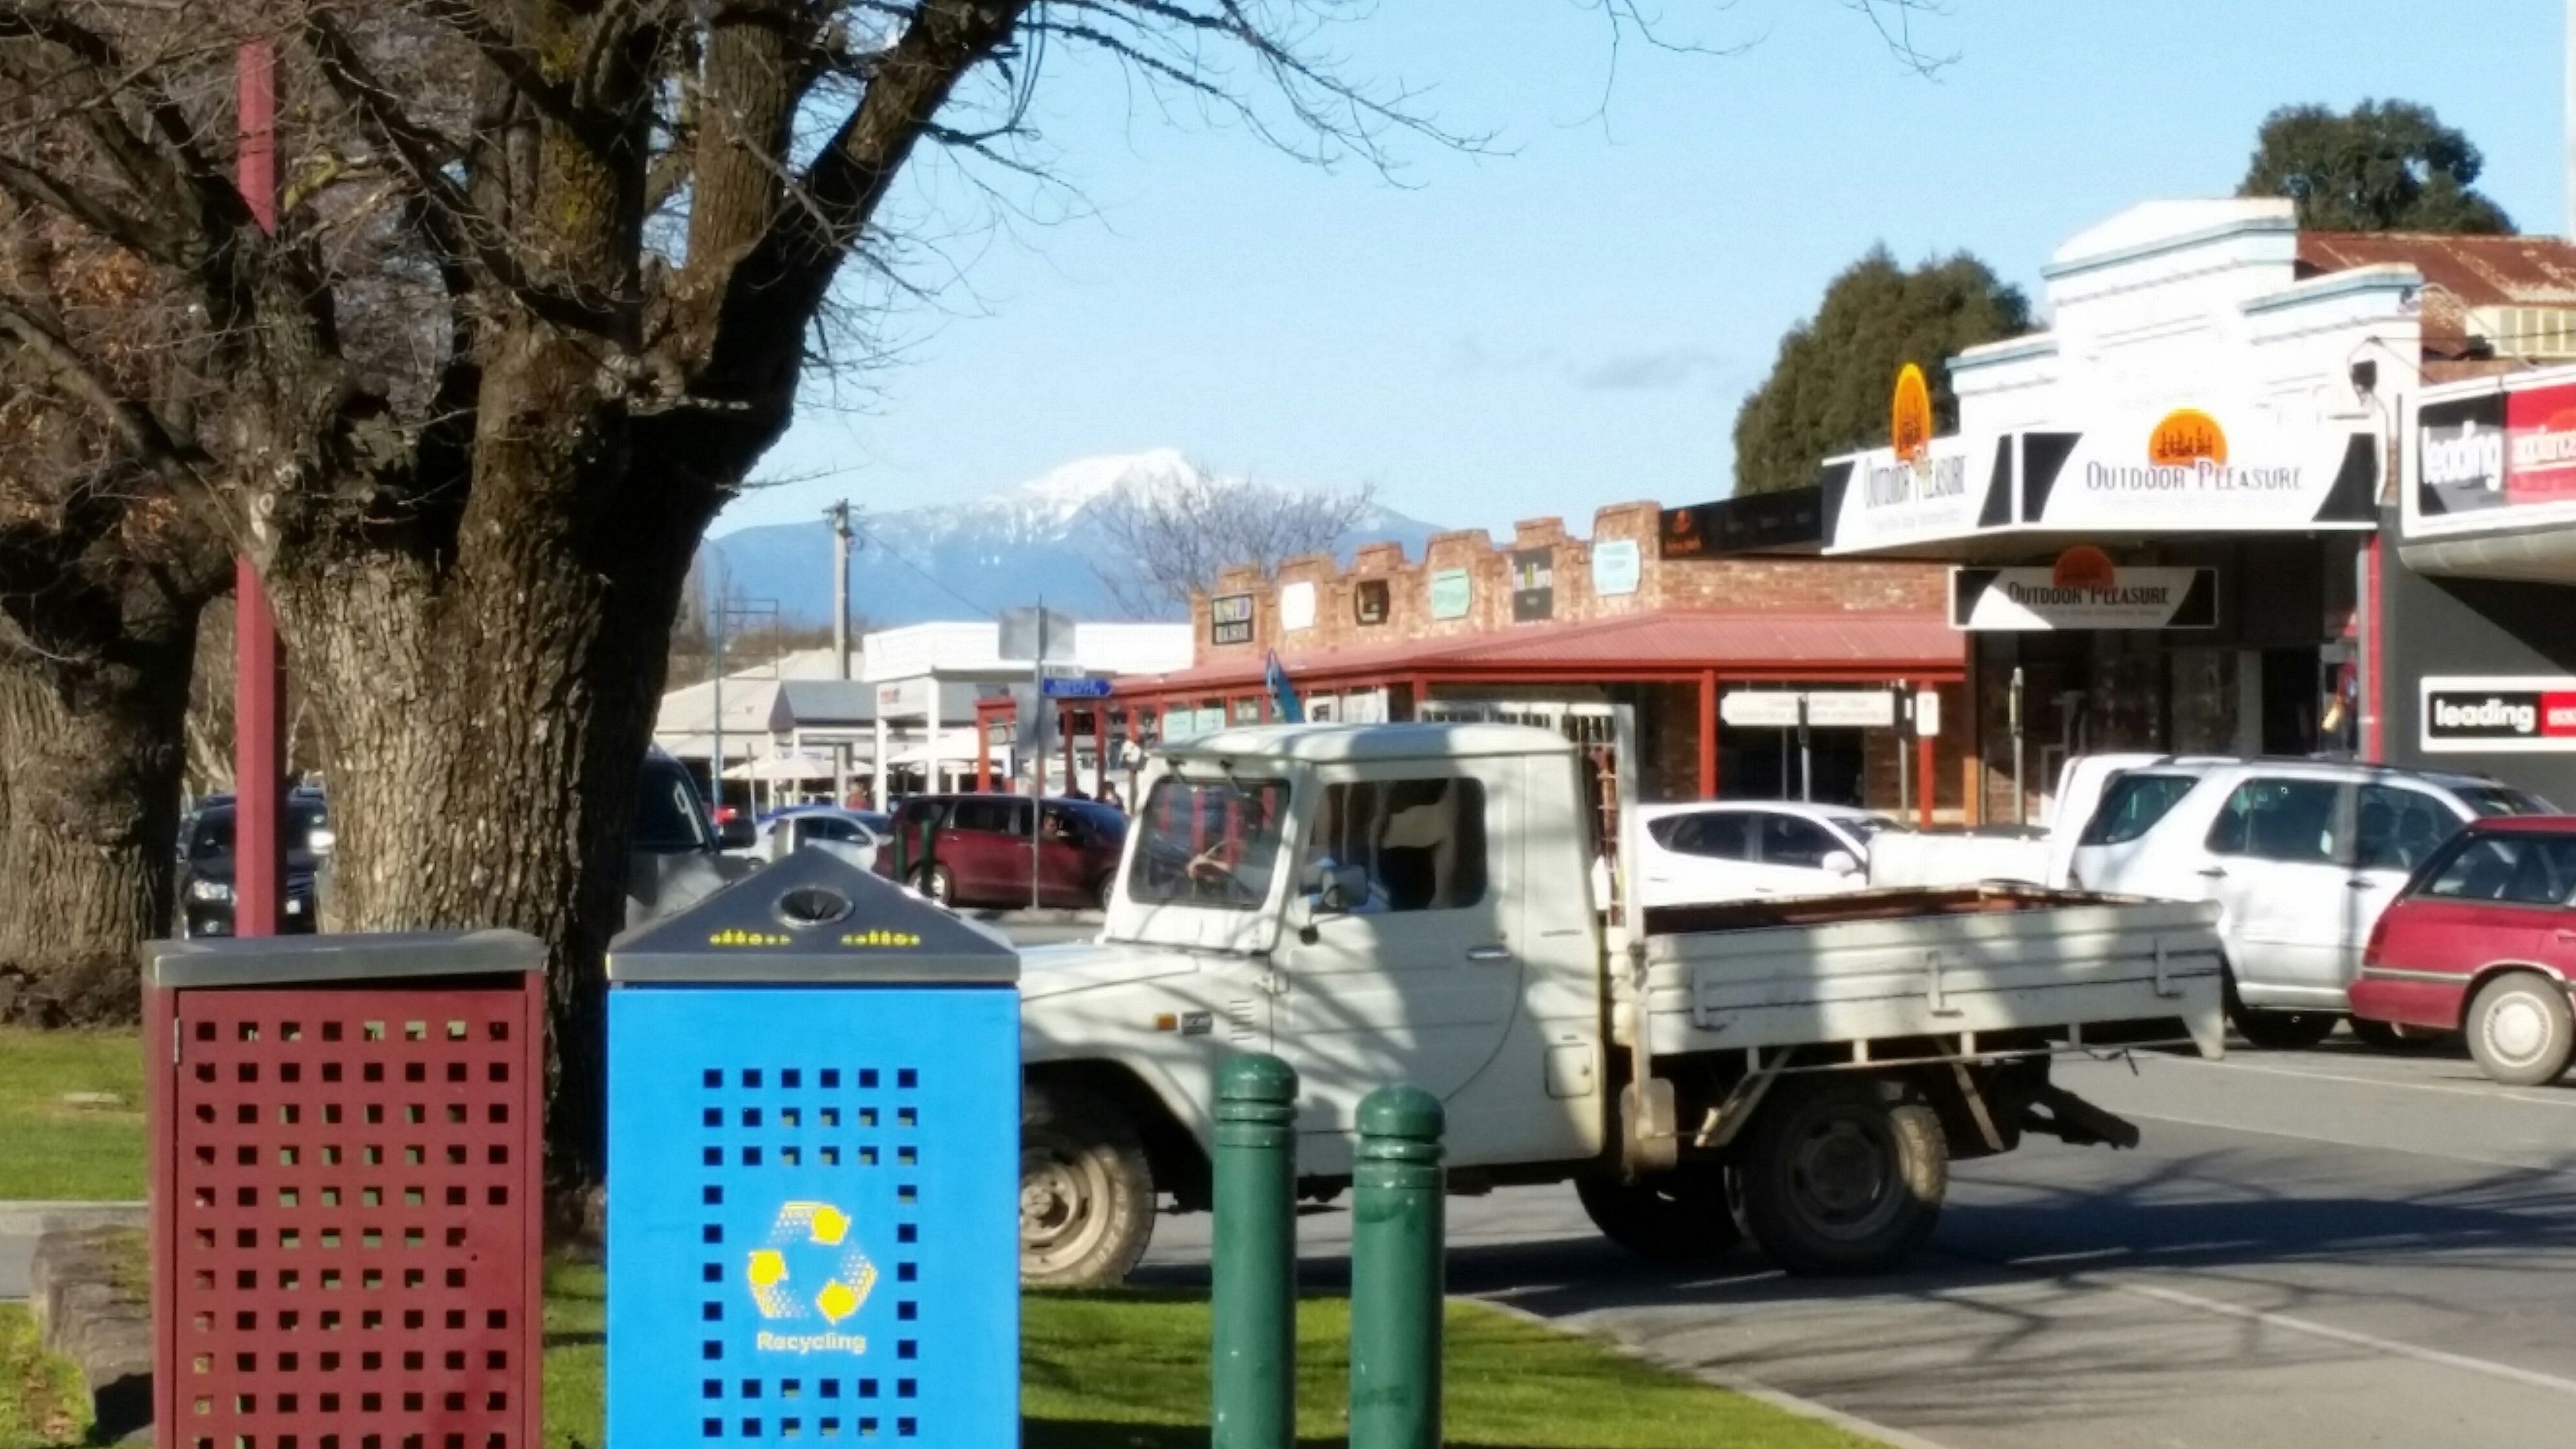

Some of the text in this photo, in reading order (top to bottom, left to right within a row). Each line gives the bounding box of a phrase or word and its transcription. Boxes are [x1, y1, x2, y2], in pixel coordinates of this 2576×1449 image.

[2422, 419, 2502, 492] leading
[2086, 461, 2304, 490] OUTDOOR PLEASURE
[2008, 582, 2169, 604] OUTDOOR PLEASURE
[2435, 698, 2534, 732] leading
[757, 1332, 866, 1354] Recycling
